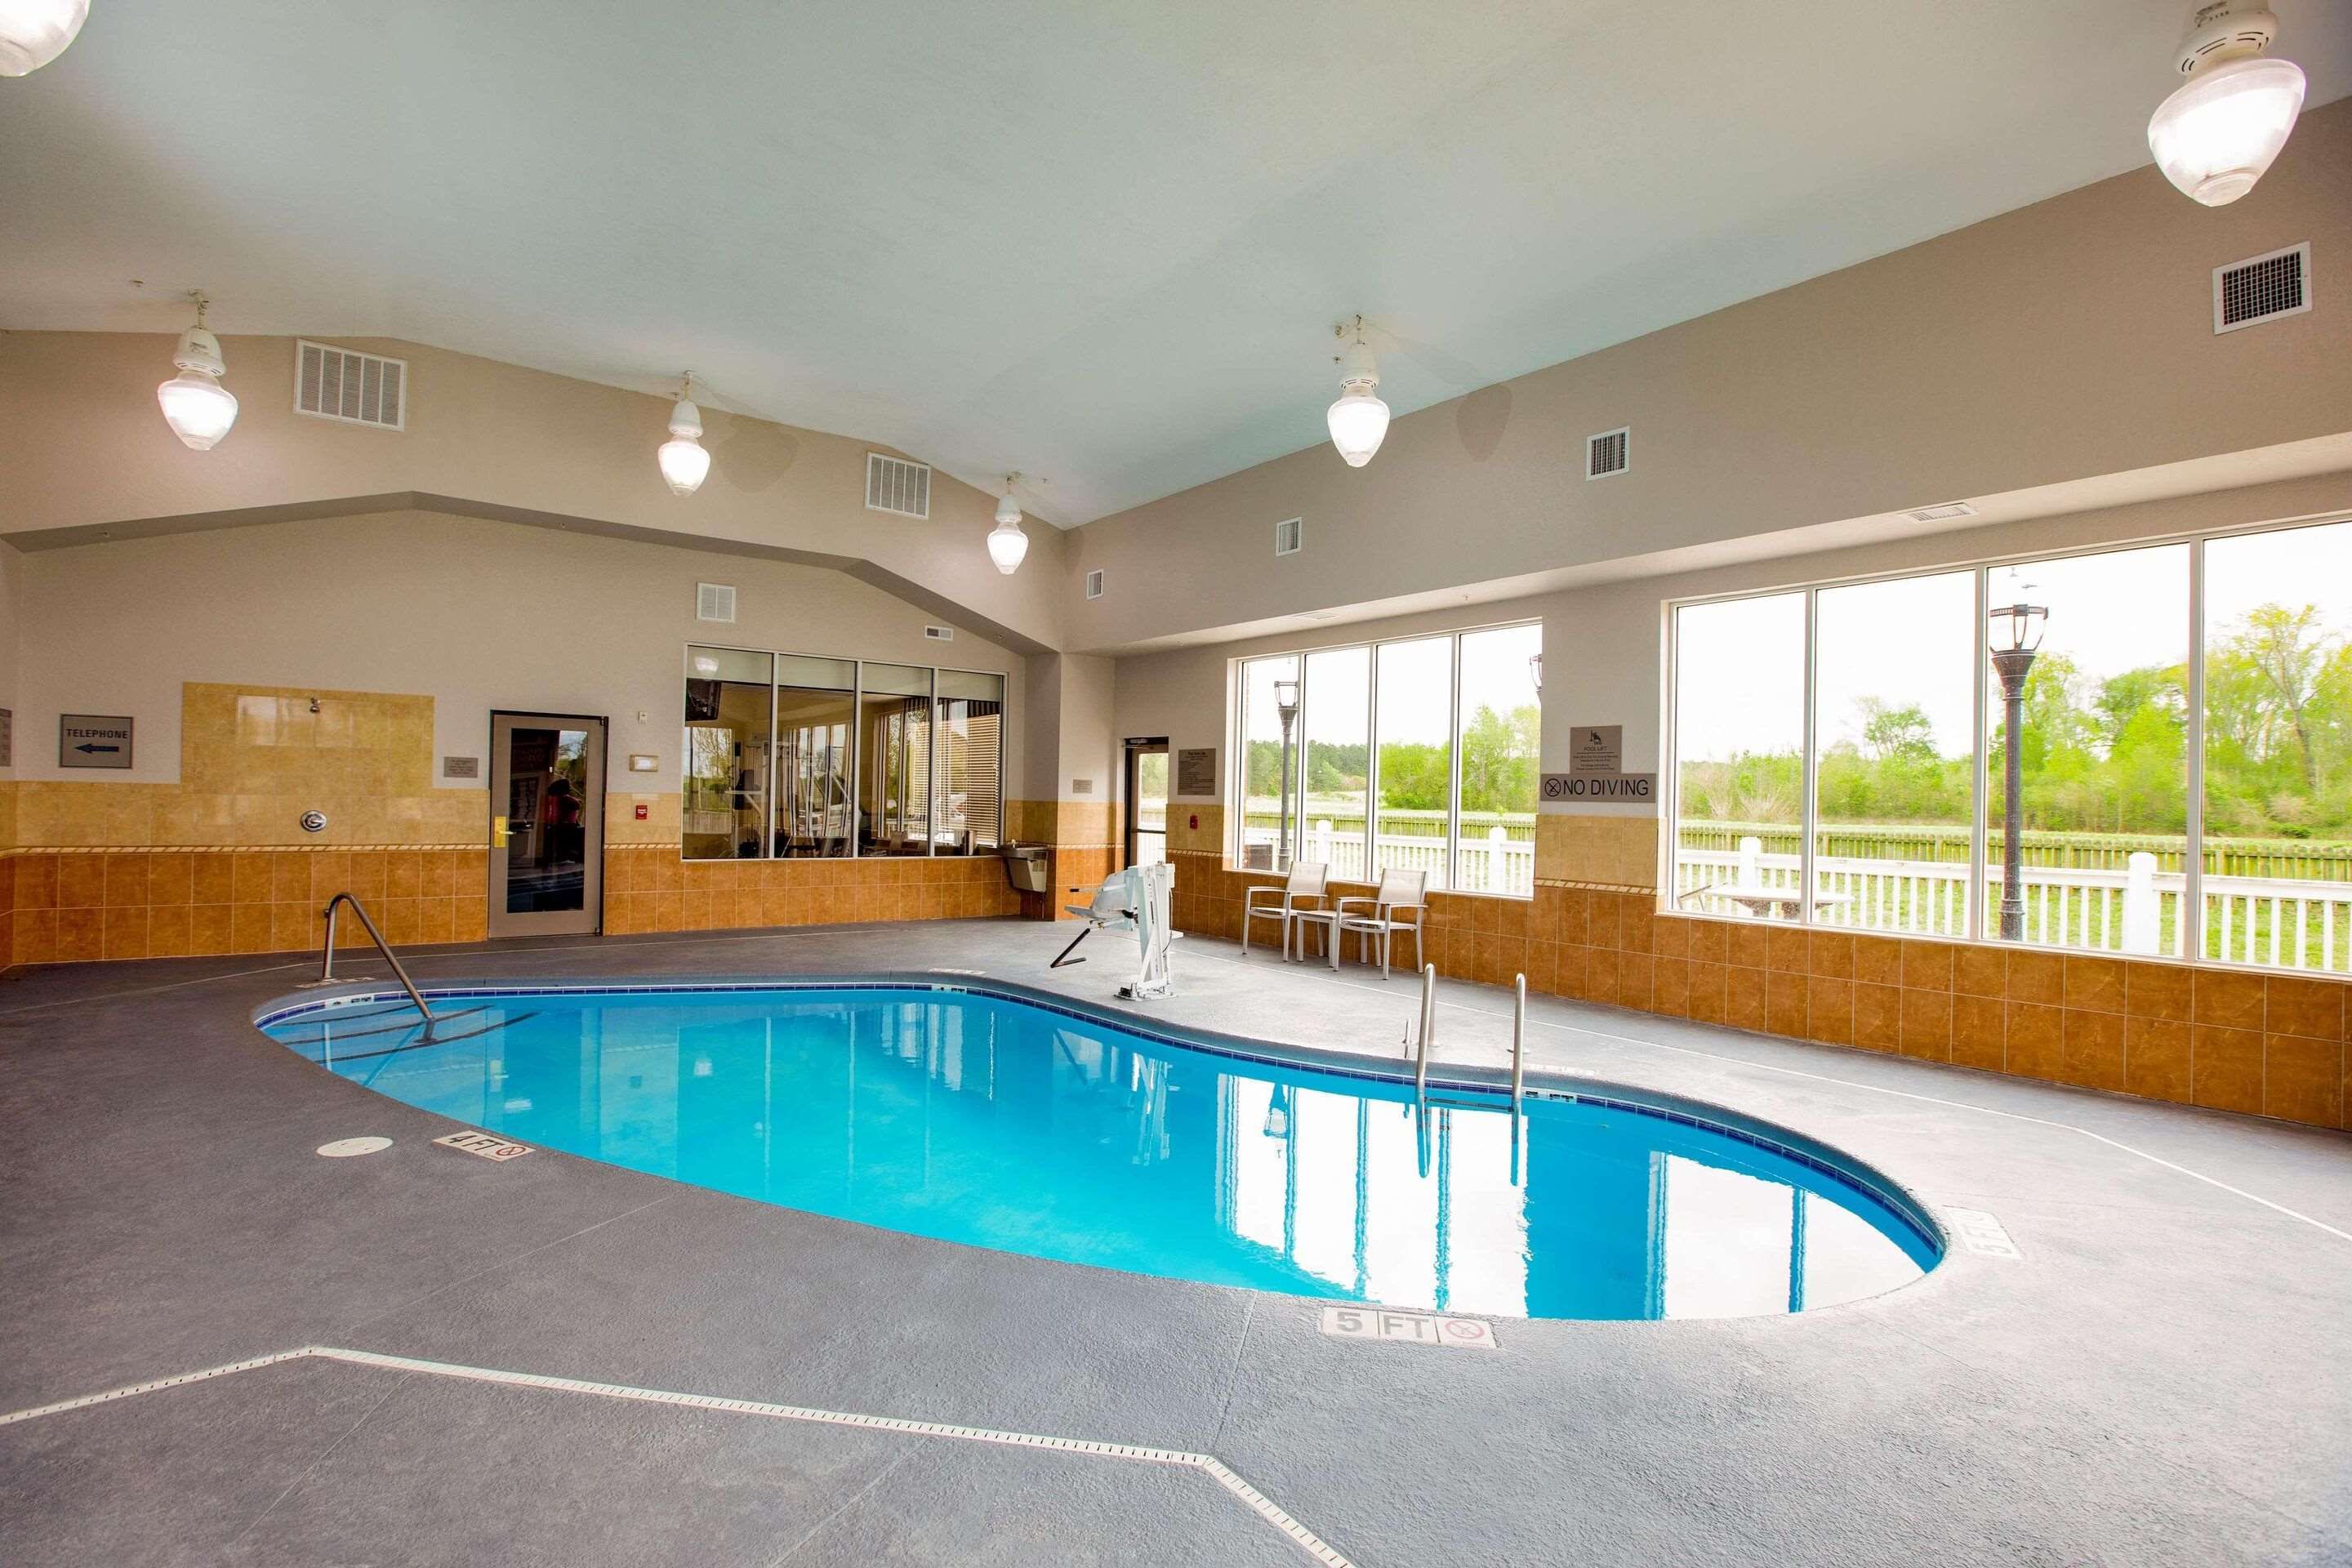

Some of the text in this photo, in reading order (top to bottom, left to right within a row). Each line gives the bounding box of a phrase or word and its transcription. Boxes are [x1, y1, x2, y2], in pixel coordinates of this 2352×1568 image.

[65, 728, 128, 739] TELEPHONE
[1563, 779, 1649, 796] NO DIVING
[1549, 1093, 1574, 1102] FT
[448, 1134, 505, 1152] 4 FT
[1336, 1311, 1429, 1339] 5 FT
